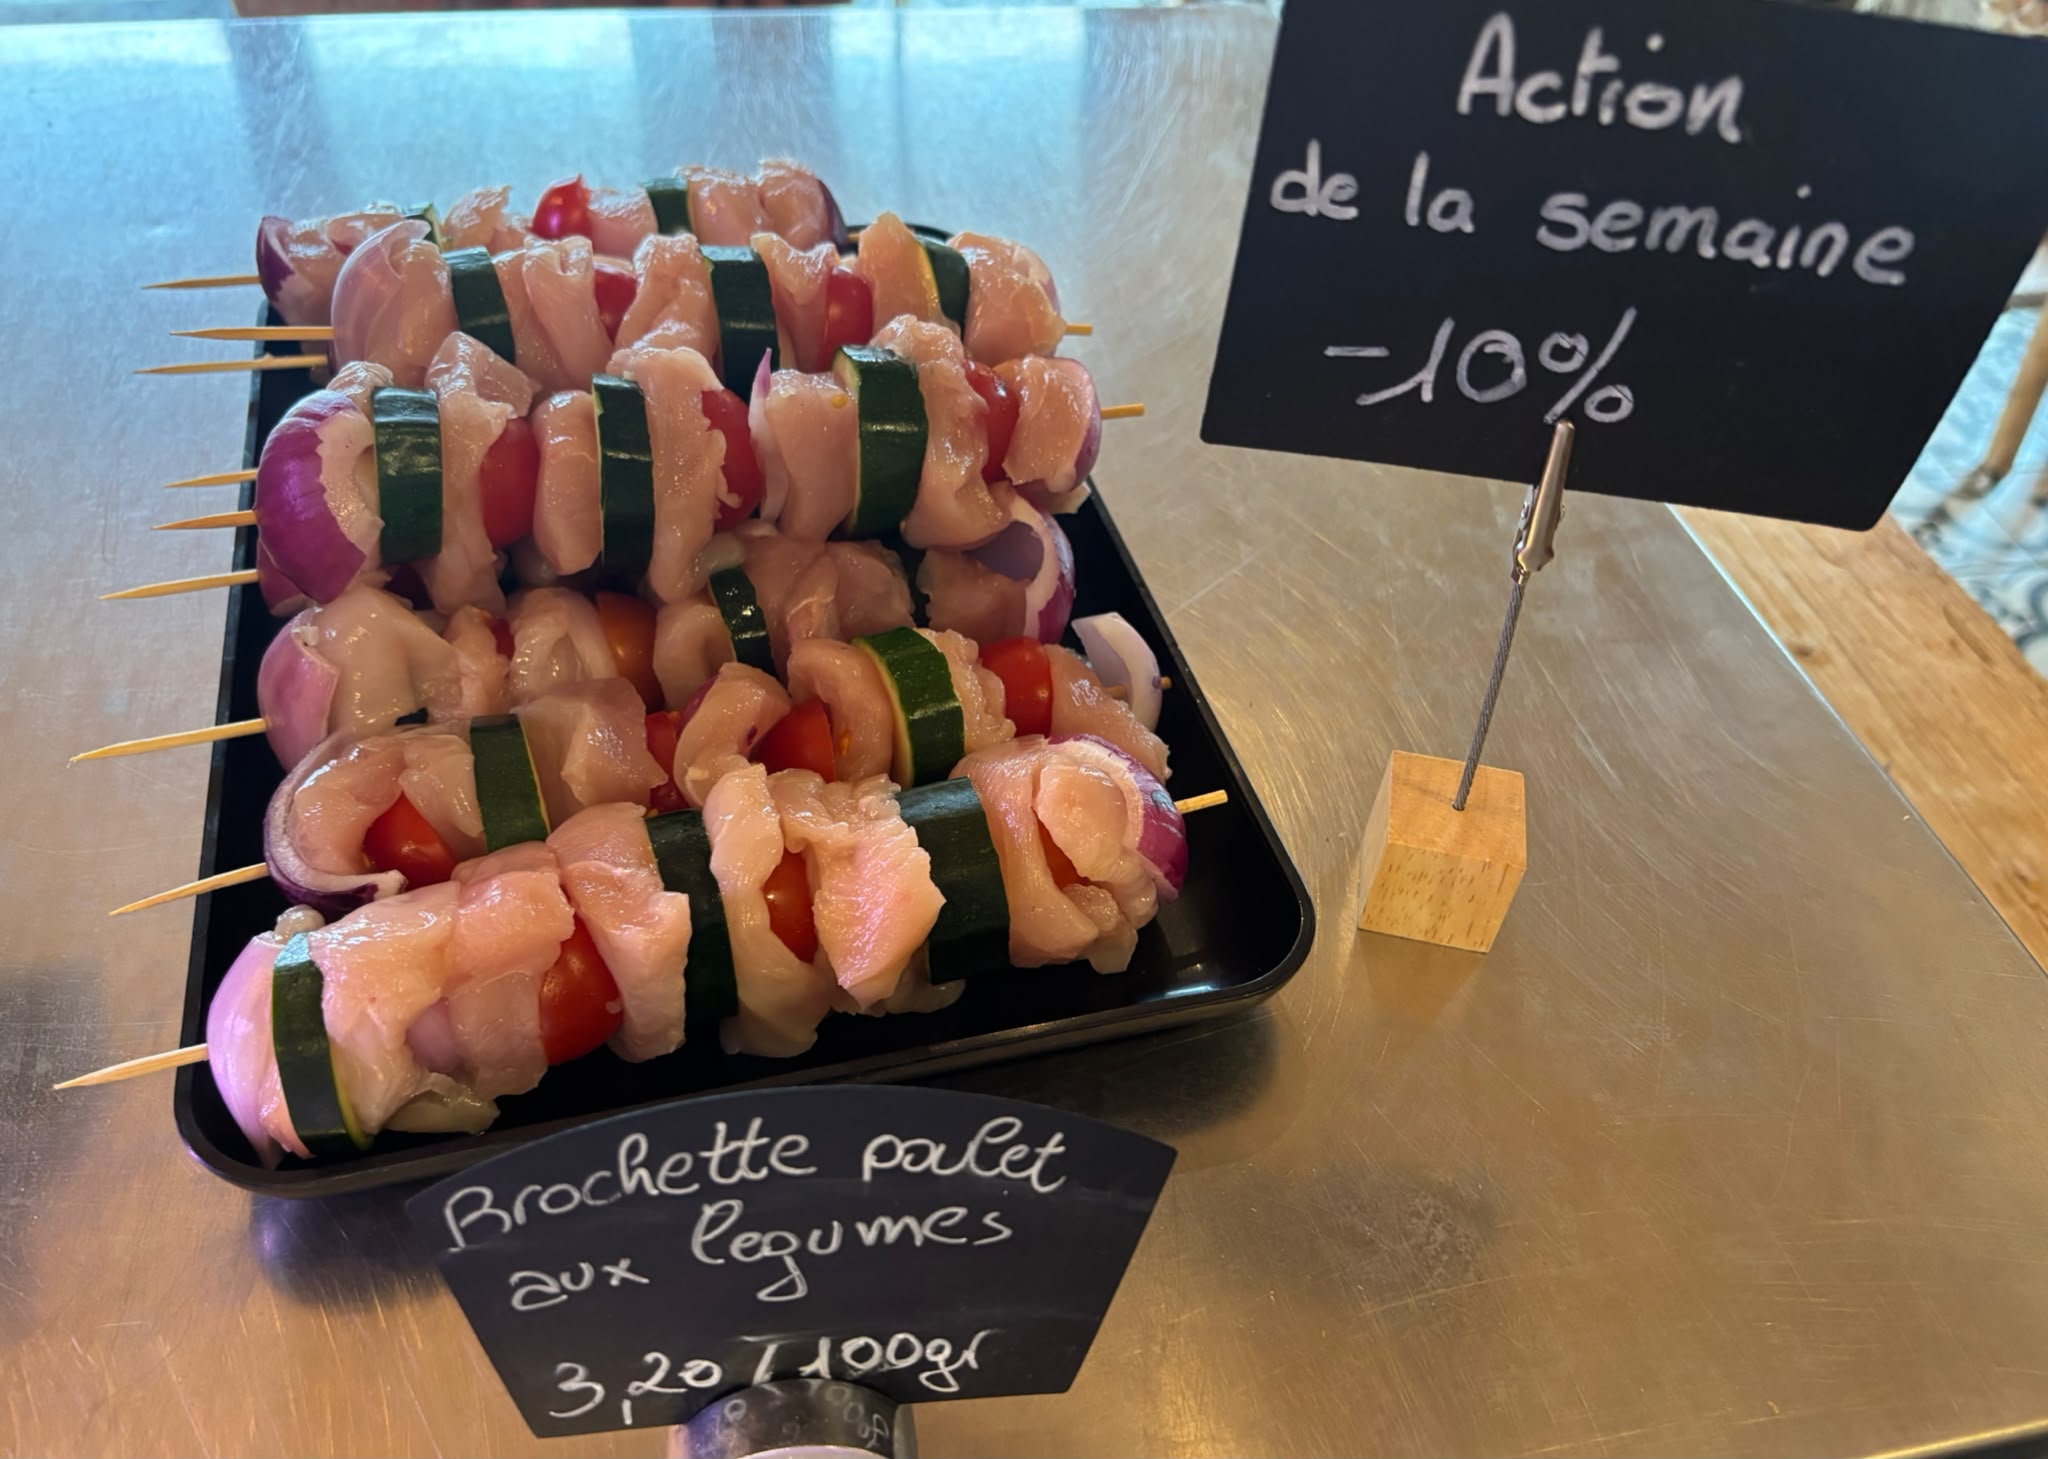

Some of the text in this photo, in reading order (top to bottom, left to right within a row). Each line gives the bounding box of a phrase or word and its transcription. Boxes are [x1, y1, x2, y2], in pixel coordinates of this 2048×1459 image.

[1456, 12, 1744, 144] Action
[1270, 139, 1916, 286] de la semaine
[1323, 306, 1637, 424] -10%
[443, 1116, 818, 1253] Brochette
[508, 1257, 650, 1311] aux
